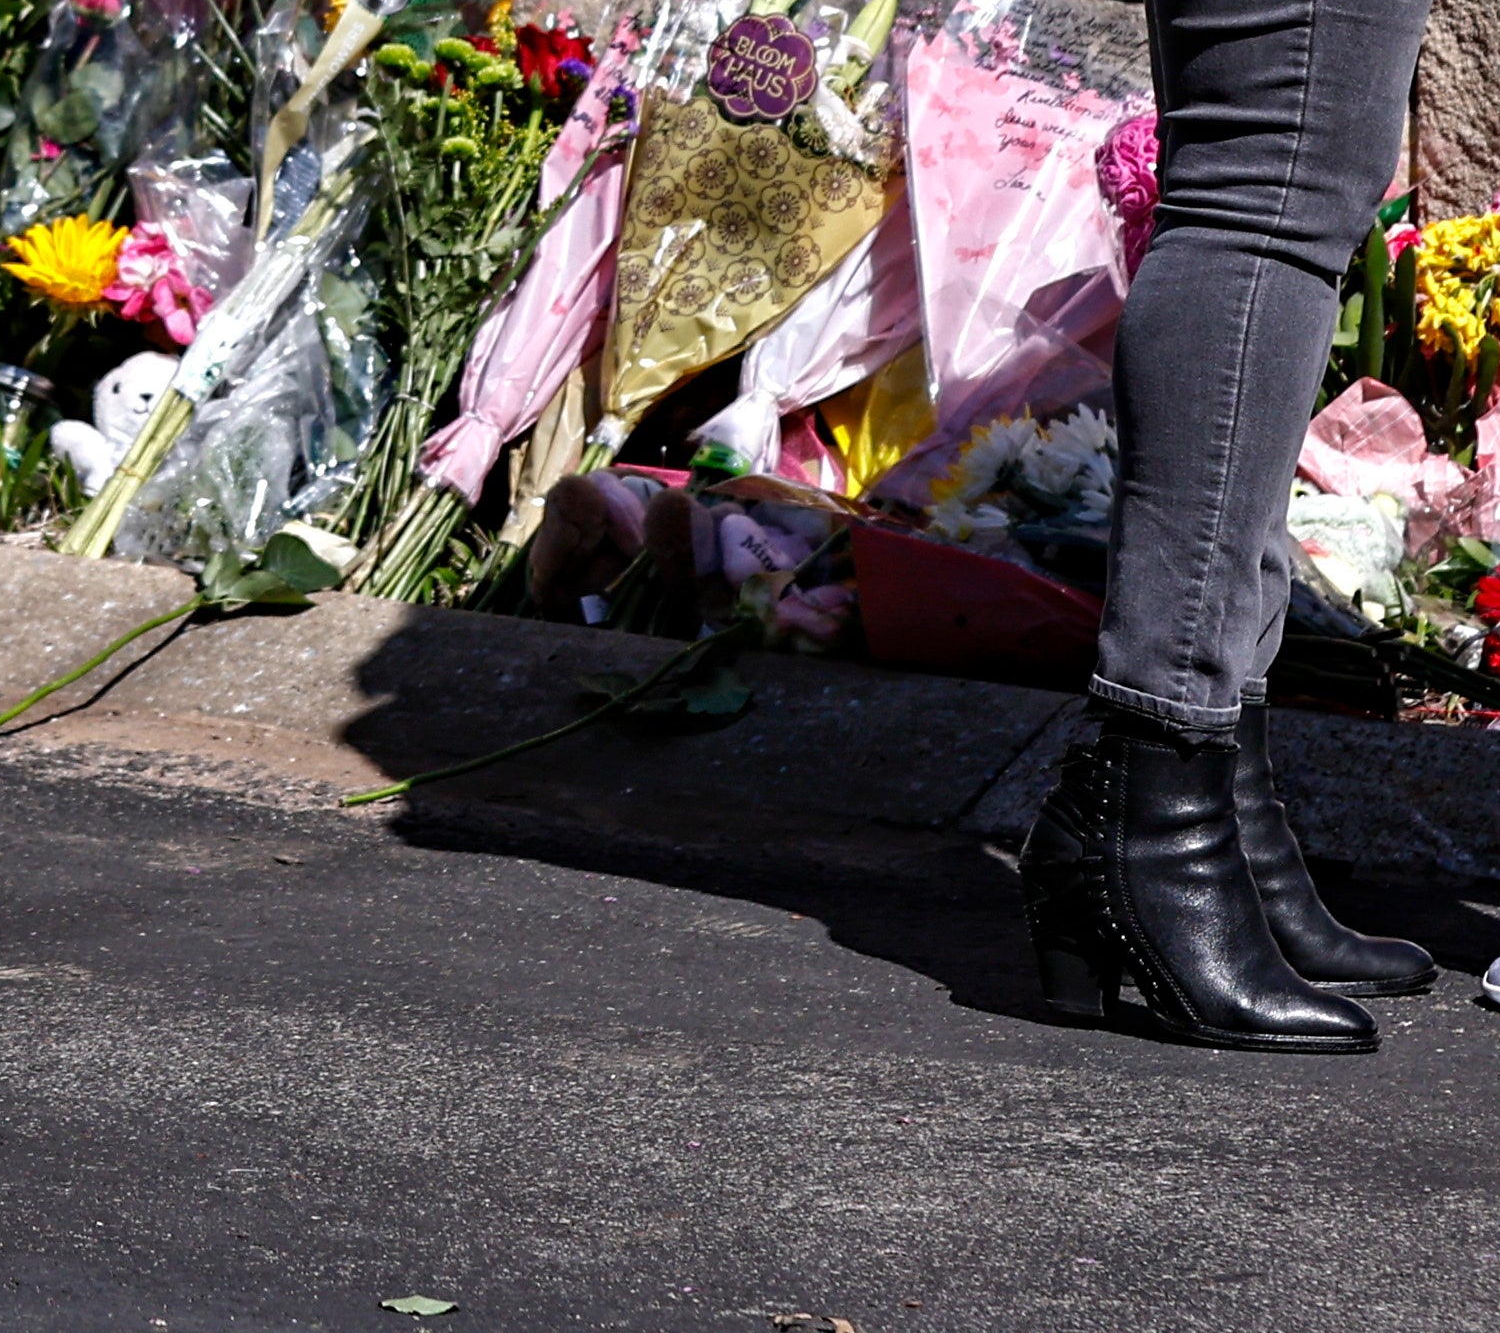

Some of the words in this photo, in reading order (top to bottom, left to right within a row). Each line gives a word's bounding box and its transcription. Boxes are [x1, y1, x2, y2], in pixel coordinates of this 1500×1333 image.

[735, 35, 796, 75] BLOOM
[723, 57, 786, 97] HAUS
[995, 107, 1036, 129] Jesus
[999, 134, 1036, 153] your
